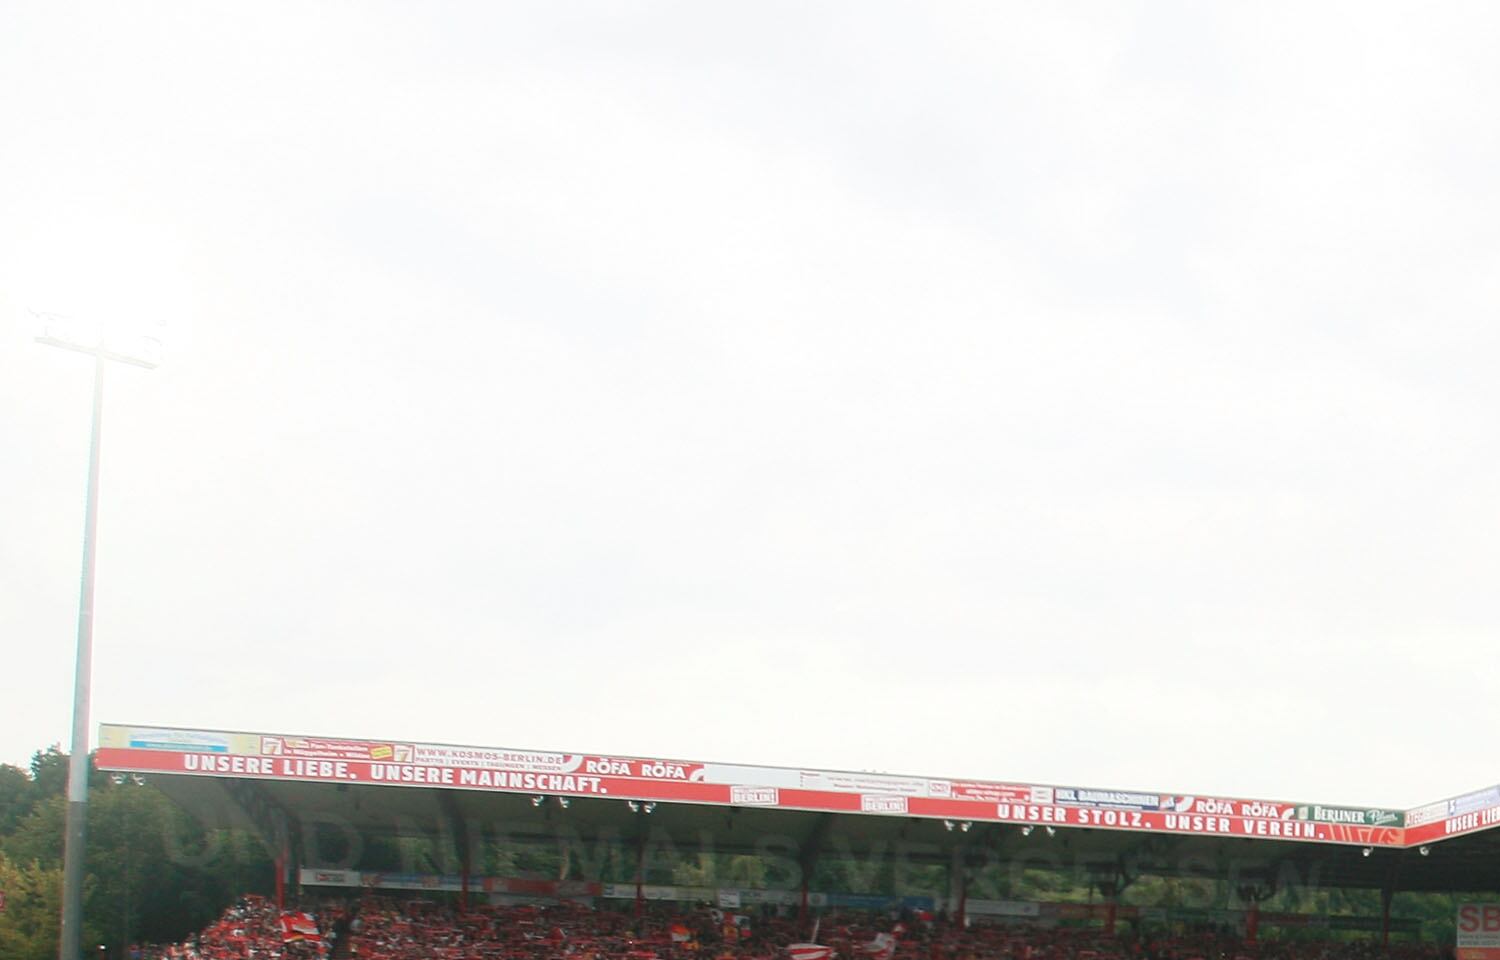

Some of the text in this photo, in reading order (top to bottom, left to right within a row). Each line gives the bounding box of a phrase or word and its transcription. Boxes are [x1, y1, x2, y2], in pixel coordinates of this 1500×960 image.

[416, 748, 562, 765] WWW.KOSMOS-BERLIN.DE
[184, 753, 273, 775] UNSERE
[284, 759, 357, 780] LIEBE.
[371, 765, 454, 784] UNSERE
[459, 770, 607, 794] MANNSCHAFT.
[586, 758, 631, 776] RÖFA
[641, 762, 686, 780] RÖFA
[1196, 798, 1233, 816] RÖFA
[1242, 800, 1279, 818] RÖFA
[1314, 806, 1366, 824] BERLINER
[997, 804, 1325, 839] UNSER STOLZ. UNSER VEREIN.
[1445, 812, 1479, 834] UNSERE
